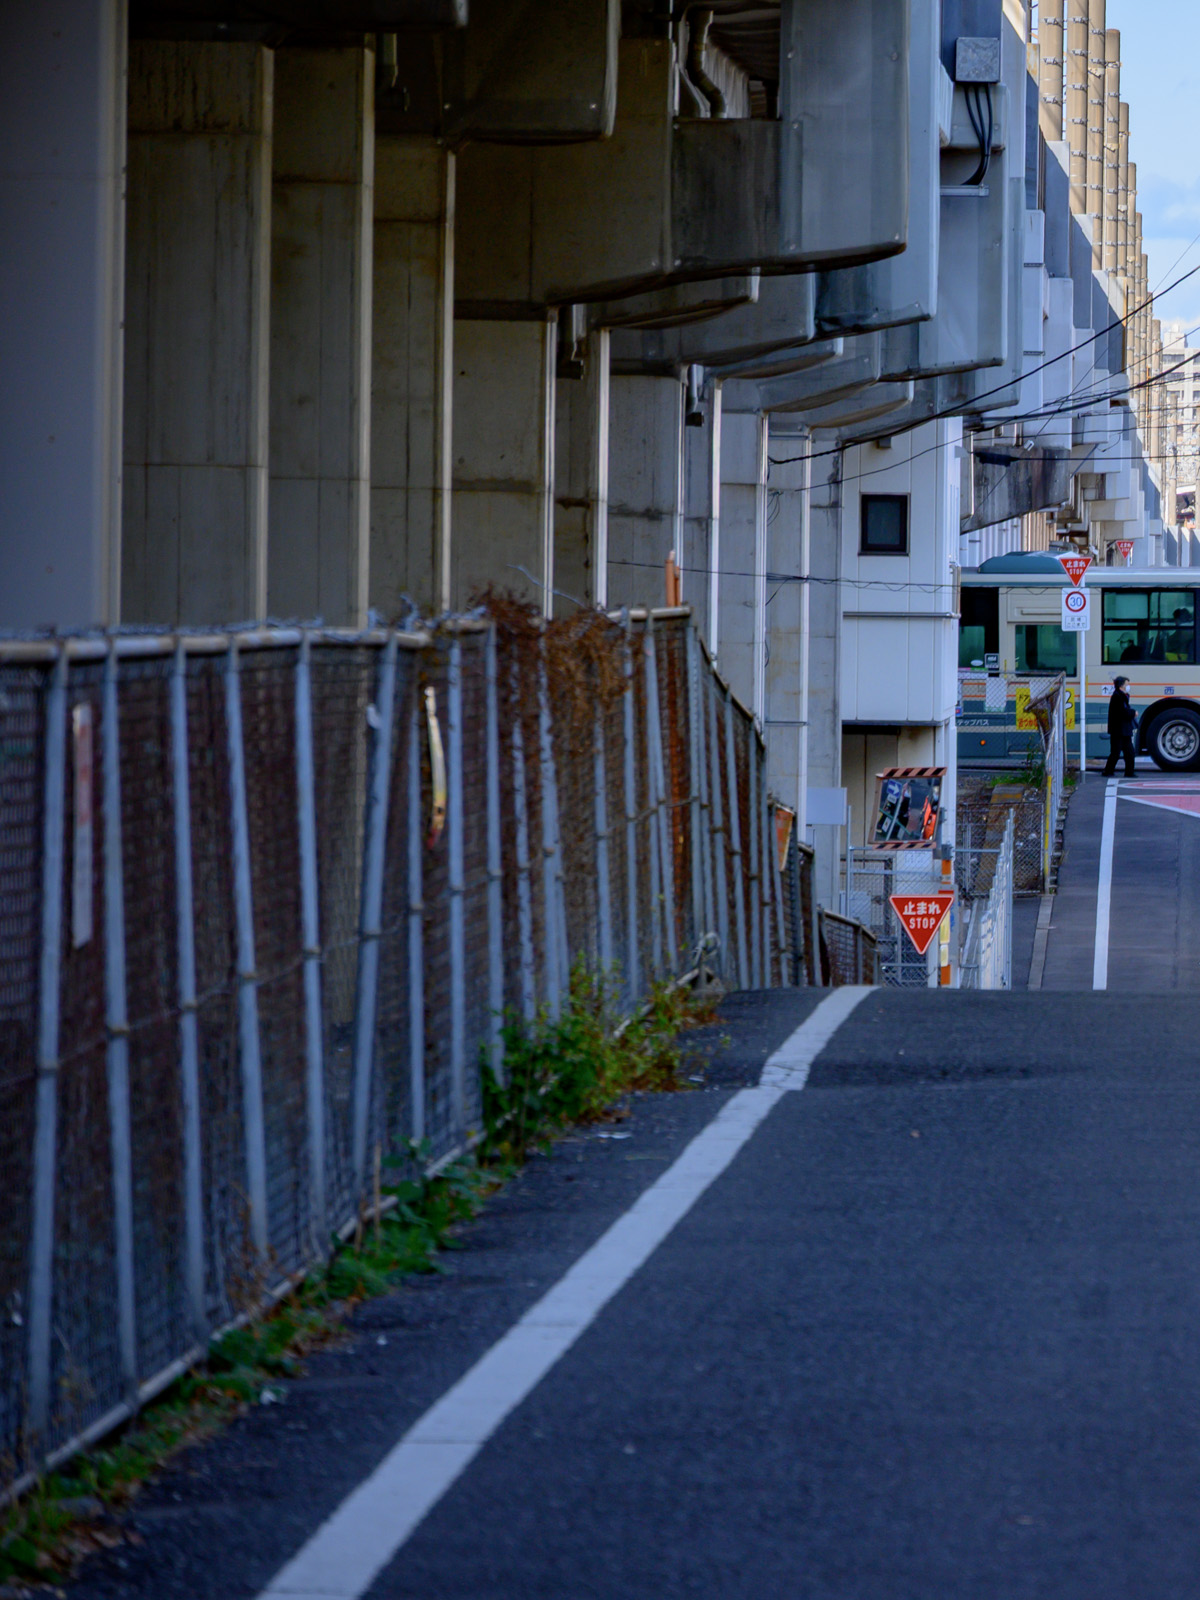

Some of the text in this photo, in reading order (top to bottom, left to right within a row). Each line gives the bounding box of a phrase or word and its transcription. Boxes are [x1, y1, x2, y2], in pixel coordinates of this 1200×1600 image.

[1066, 560, 1086, 568] 止まれ
[1070, 596, 1082, 607] 30
[902, 901, 941, 916] 止まれ
[909, 917, 936, 929] STOP
